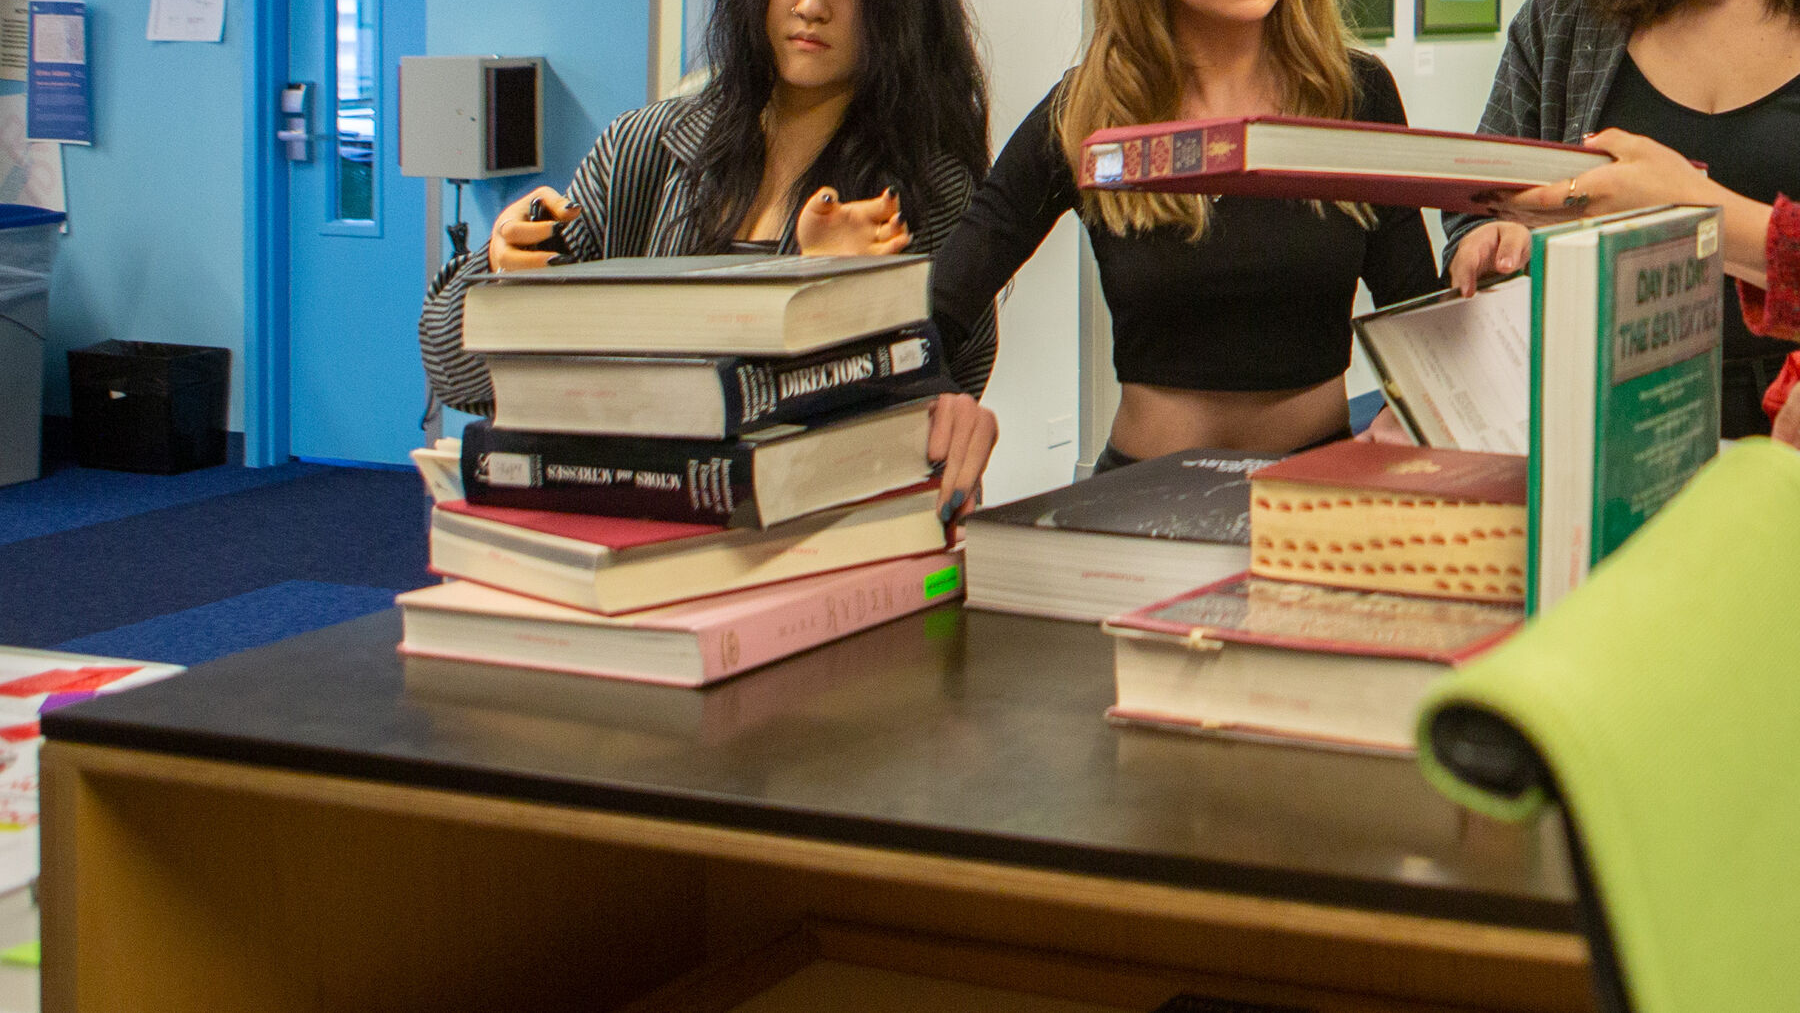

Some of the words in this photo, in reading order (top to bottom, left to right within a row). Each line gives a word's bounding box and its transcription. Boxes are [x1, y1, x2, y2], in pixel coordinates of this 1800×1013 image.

[1667, 261, 1685, 297] BY
[779, 353, 874, 400] DIRECTORS
[546, 464, 613, 485] ACTRESSES
[634, 471, 683, 491] ACTORS
